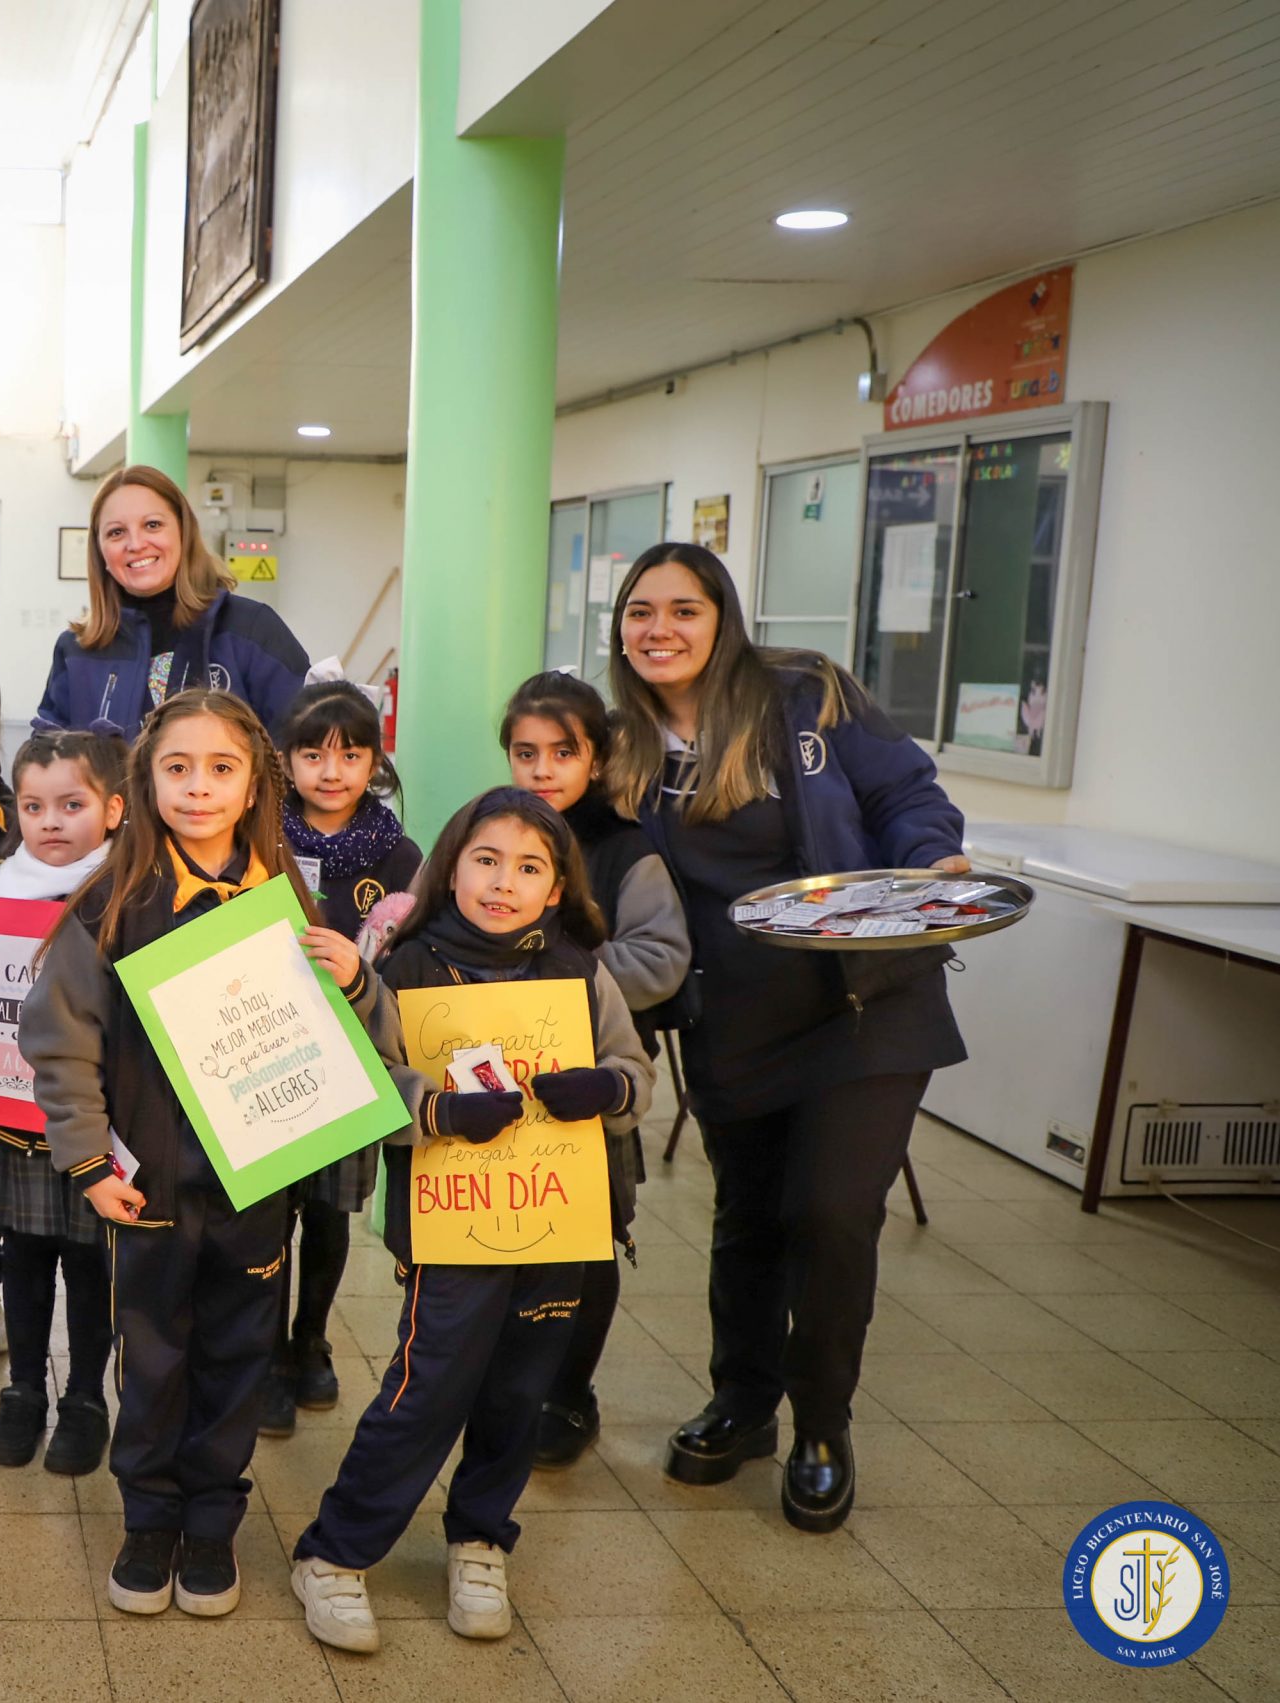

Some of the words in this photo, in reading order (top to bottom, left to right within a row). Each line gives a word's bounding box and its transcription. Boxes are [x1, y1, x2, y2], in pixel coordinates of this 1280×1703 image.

[891, 379, 993, 423] COMEDORES
[210, 1027, 247, 1058] MEJOR
[247, 1001, 301, 1040] MEDICINA
[219, 1005, 241, 1027] No
[240, 991, 270, 1016] hay
[228, 1041, 323, 1104] pensamientos
[240, 1050, 261, 1074] que
[254, 1035, 290, 1055] tener
[255, 1068, 319, 1117] ALEGRES
[530, 1142, 582, 1158] un
[415, 1173, 491, 1214] BUEN
[507, 1163, 569, 1210] DÍA
[549, 1310, 571, 1318] JOSE
